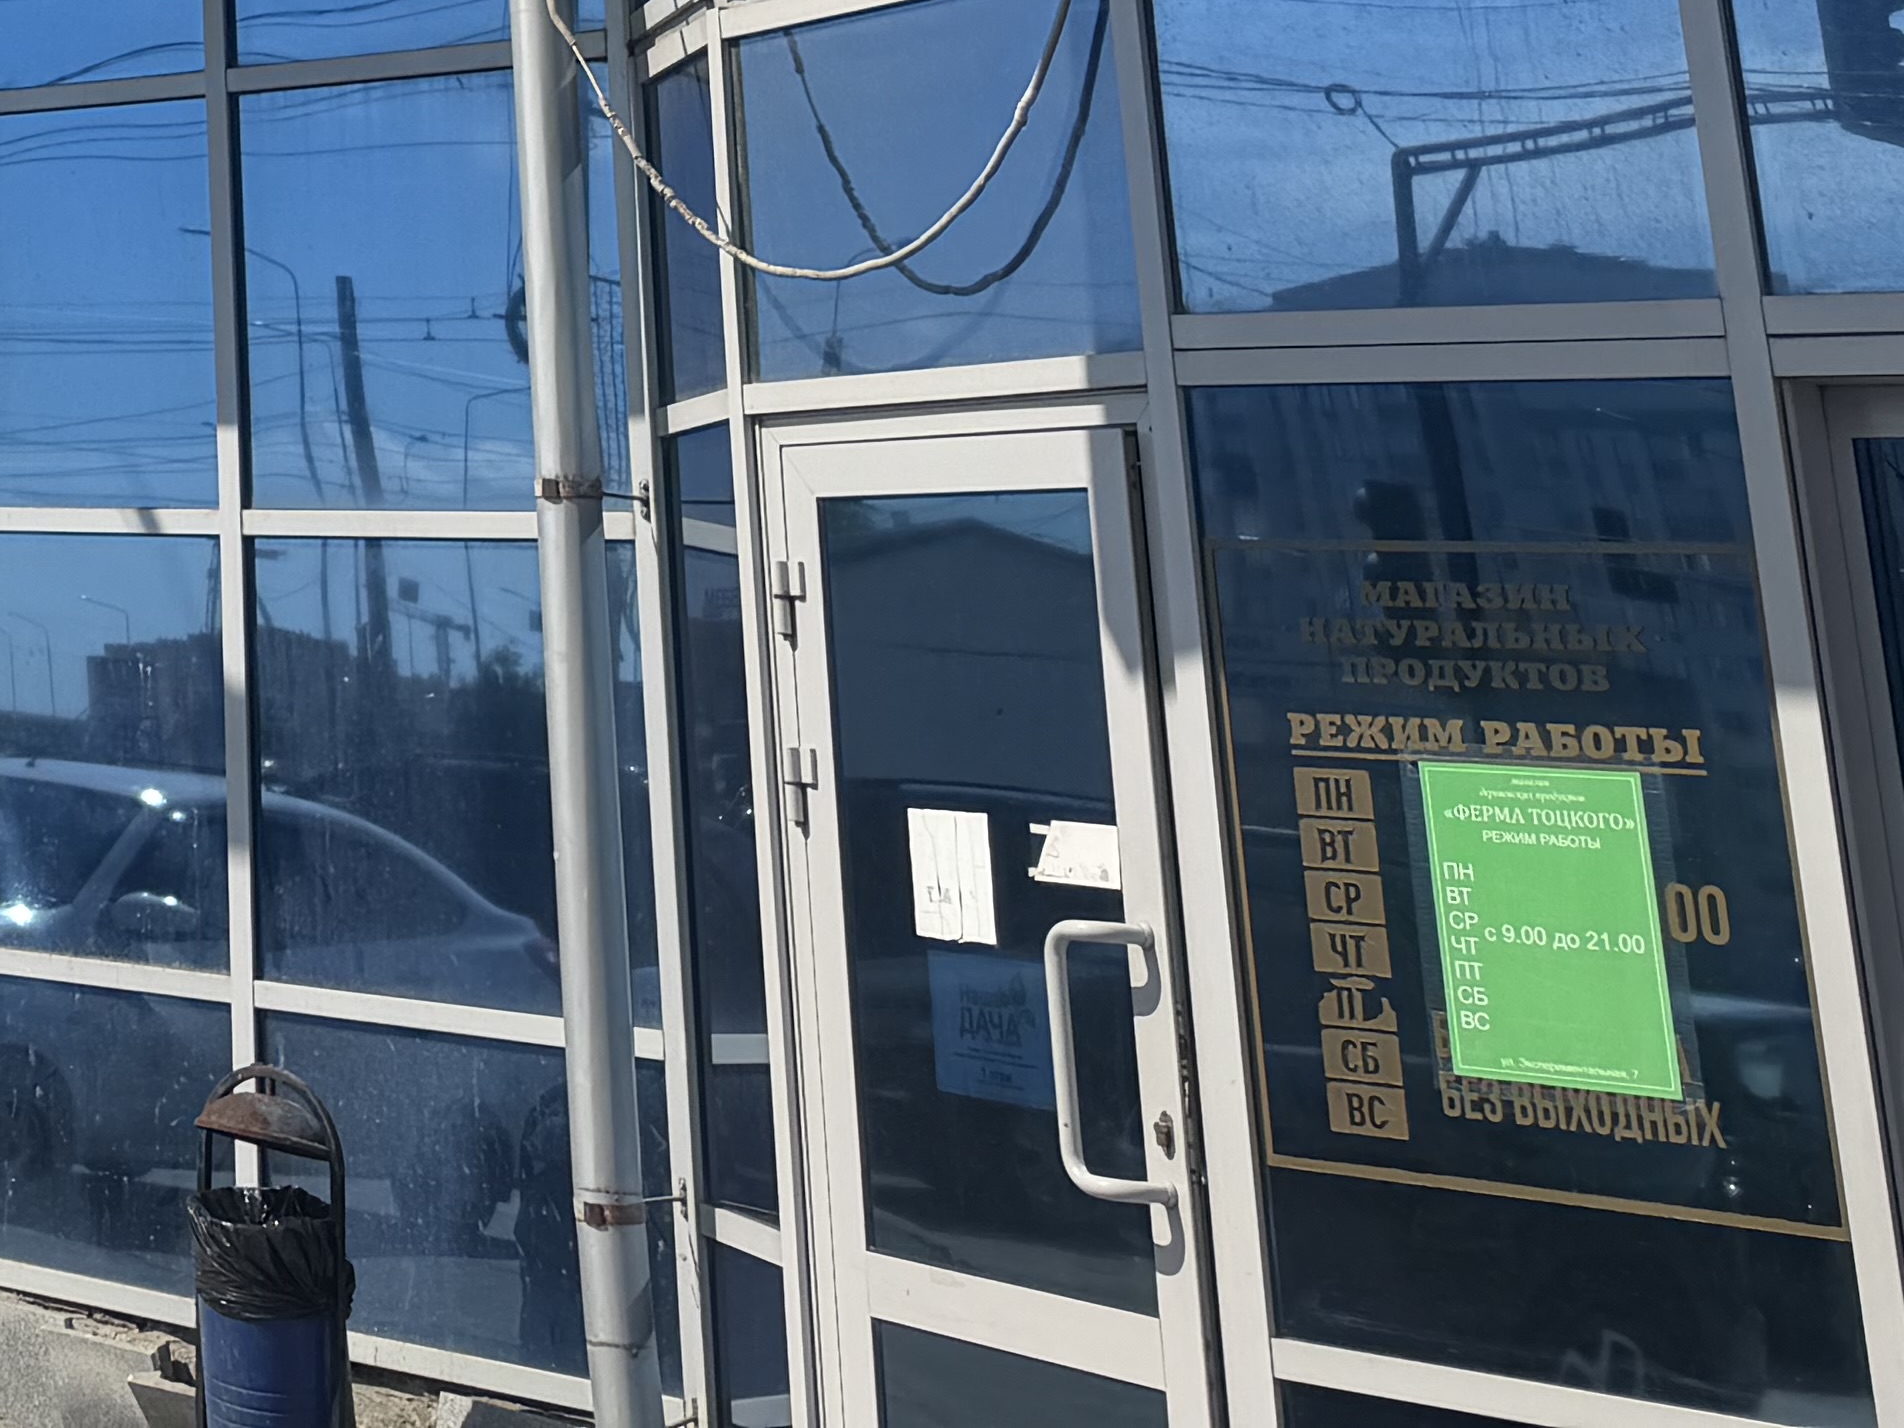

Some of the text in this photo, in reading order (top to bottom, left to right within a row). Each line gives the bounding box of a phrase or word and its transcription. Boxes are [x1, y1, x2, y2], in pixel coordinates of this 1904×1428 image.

[1359, 579, 1571, 612] МАГАЗИН
[1299, 616, 1649, 654] НАТУРАЛЬНЫХ
[1341, 655, 1610, 693] ПРОДУКТОВ
[1286, 711, 1706, 764] РЕЖИМ РАБОТЫ
[1312, 775, 1354, 813] ПН
[1443, 804, 1635, 830] «ФЕРМА ТОЦКОГО»
[1316, 826, 1356, 865] ВТ
[1482, 830, 1601, 849] РЕЖИМ РАБОТЫ
[1443, 861, 1475, 882] ПН
[1324, 880, 1362, 916] СР
[1446, 886, 1472, 905] ВТ
[1449, 911, 1479, 930] СР
[1328, 933, 1367, 970] ЧТ
[1451, 936, 1479, 955] ЧТ
[1484, 924, 1645, 954] с 9.00 до 21.00
[1454, 961, 1483, 980] ПТ
[1458, 986, 1489, 1005] СБ
[1460, 1011, 1490, 1031] ВС
[1341, 1038, 1380, 1075] СБ
[1345, 1092, 1390, 1130] ВС
[1440, 1074, 1727, 1149] БЕЗ ВЫХОДНЫХ
